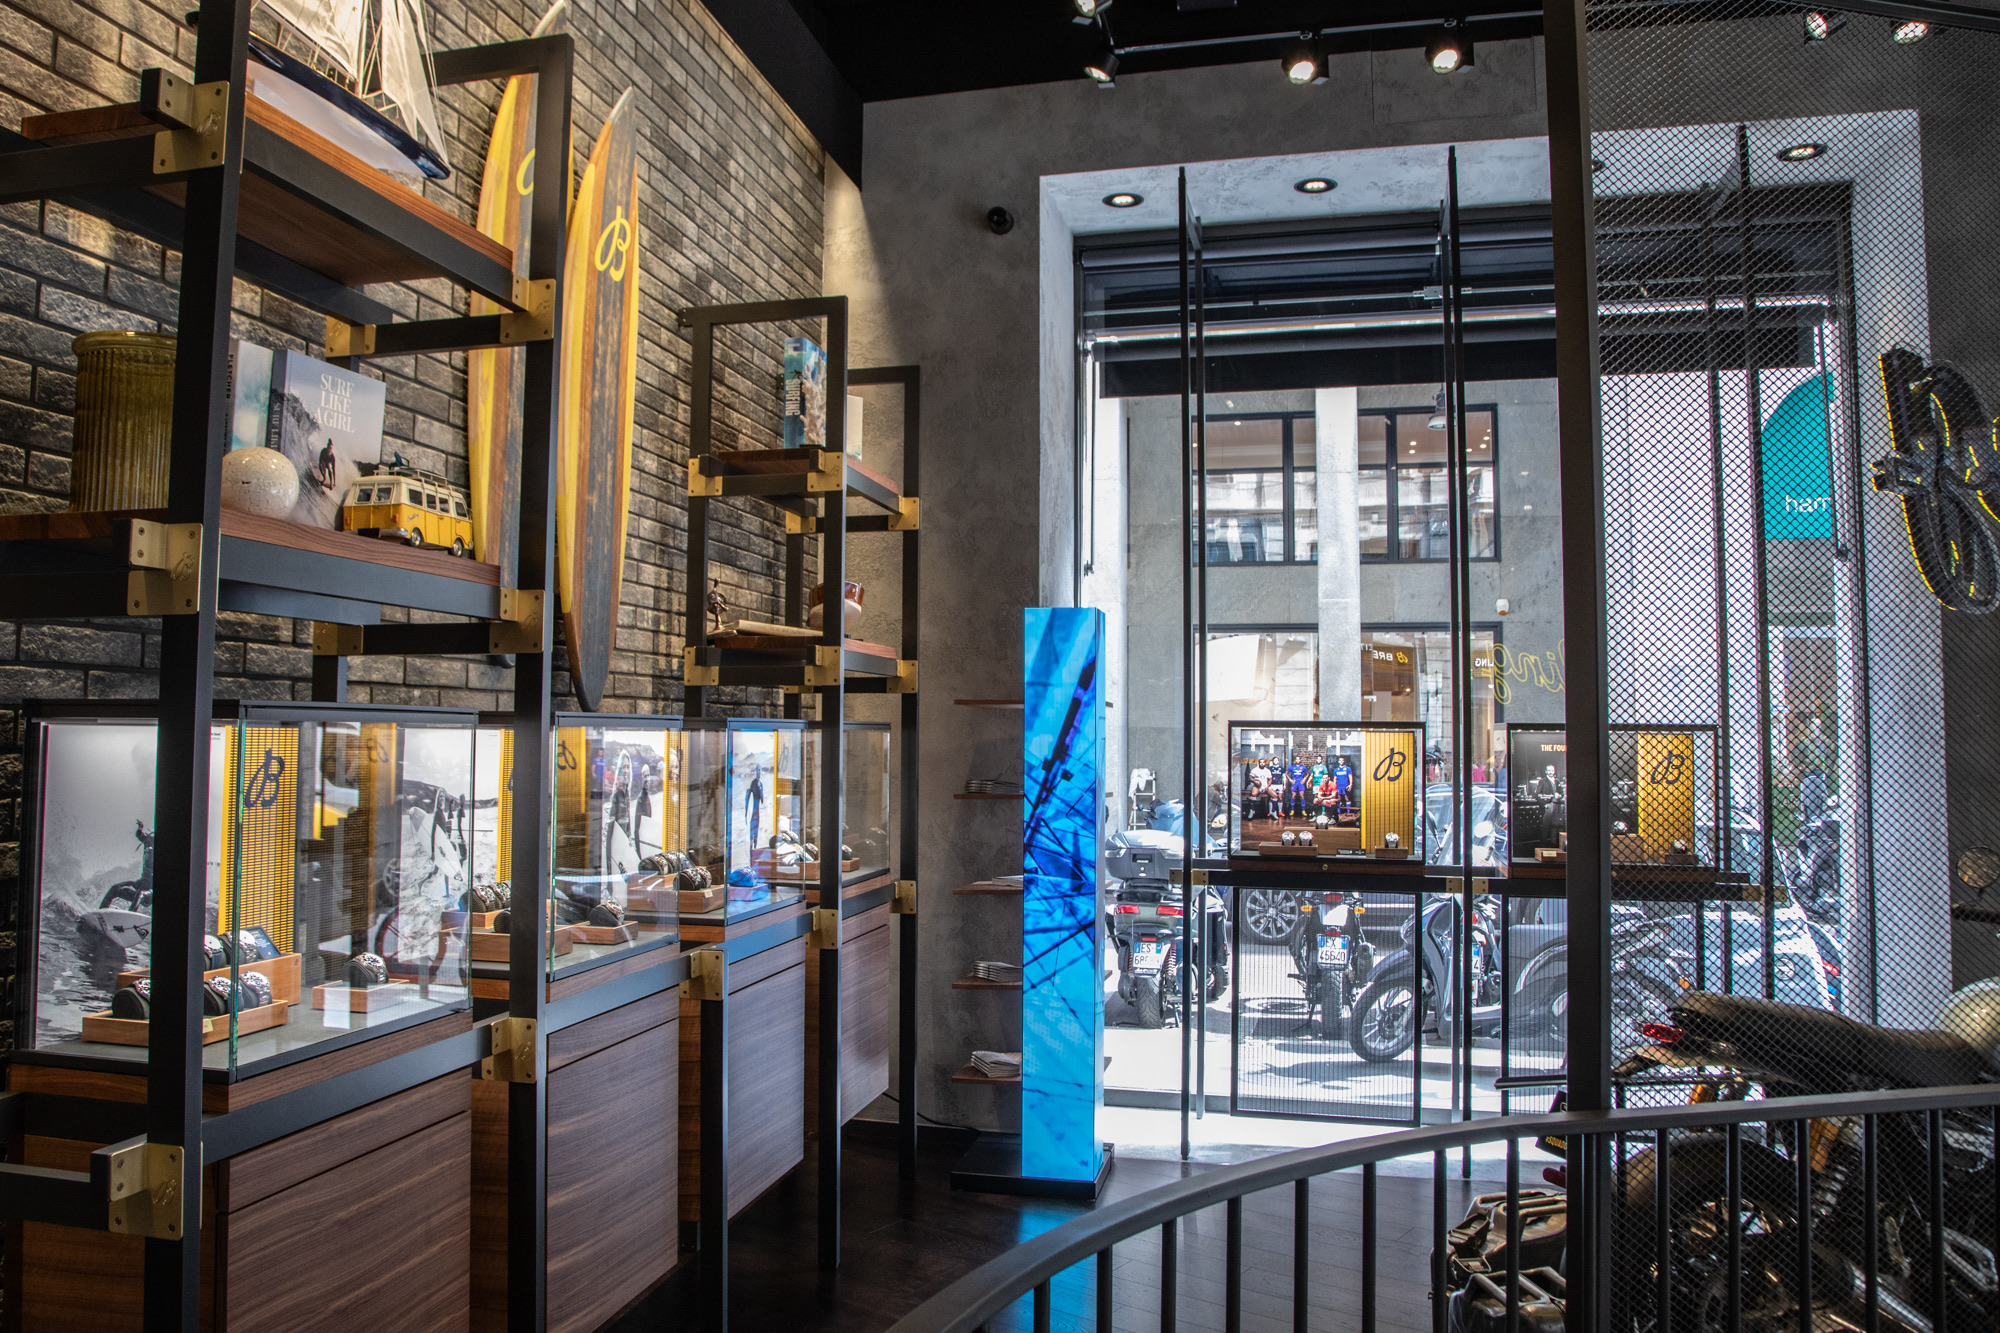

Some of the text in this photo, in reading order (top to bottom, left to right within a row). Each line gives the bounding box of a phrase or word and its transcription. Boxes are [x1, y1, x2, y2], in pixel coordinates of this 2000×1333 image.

[320, 373, 355, 396] SURF
[320, 391, 353, 415] LIKE
[785, 379, 801, 416] SURFING
[272, 402, 280, 426] SURF
[315, 408, 355, 433] A GIRL
[1141, 943, 1152, 953] ES
